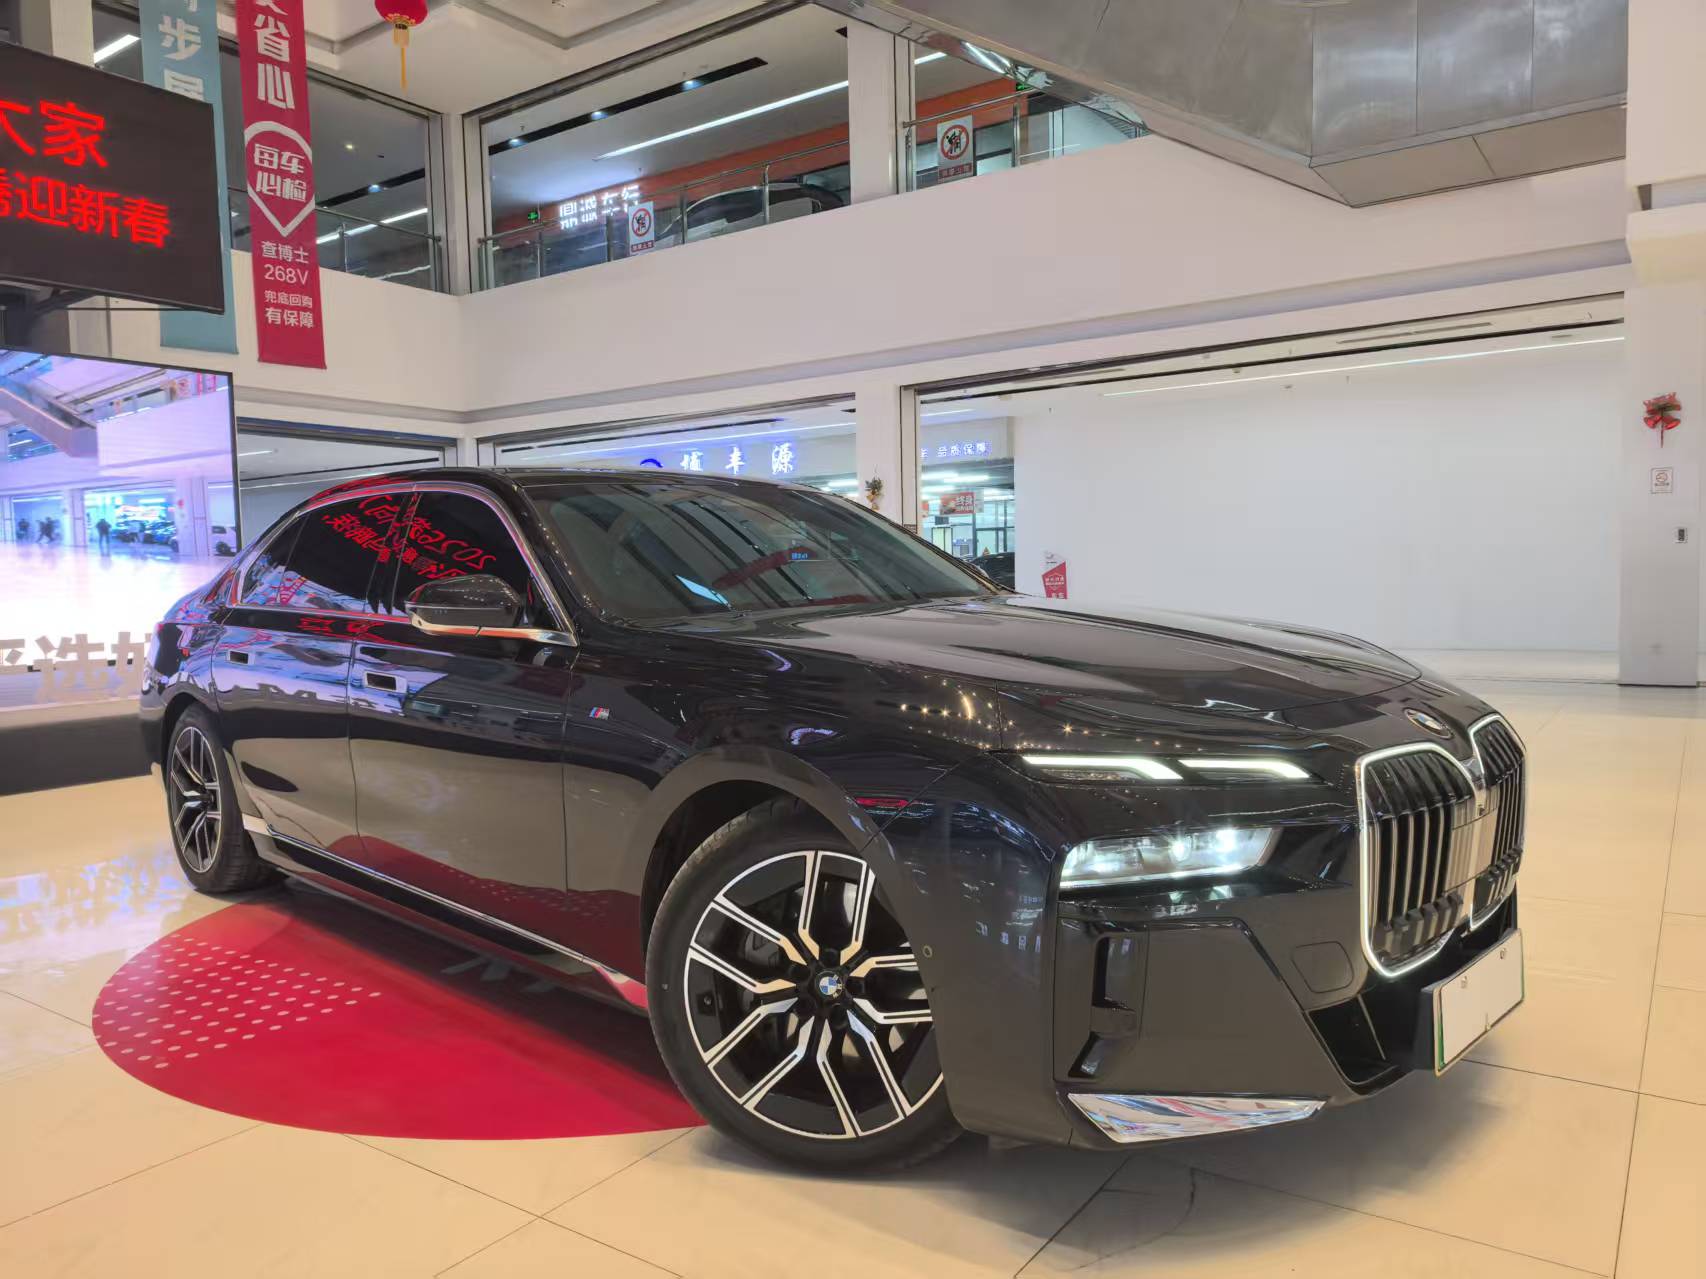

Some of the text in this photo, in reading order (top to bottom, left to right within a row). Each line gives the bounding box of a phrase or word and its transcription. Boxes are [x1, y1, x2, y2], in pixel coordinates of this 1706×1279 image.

[253, 143, 305, 175] 每车
[261, 240, 310, 265] 查博士
[263, 264, 309, 286] 268V
[264, 290, 313, 308] 兜底回购
[265, 307, 314, 329] 有保障
